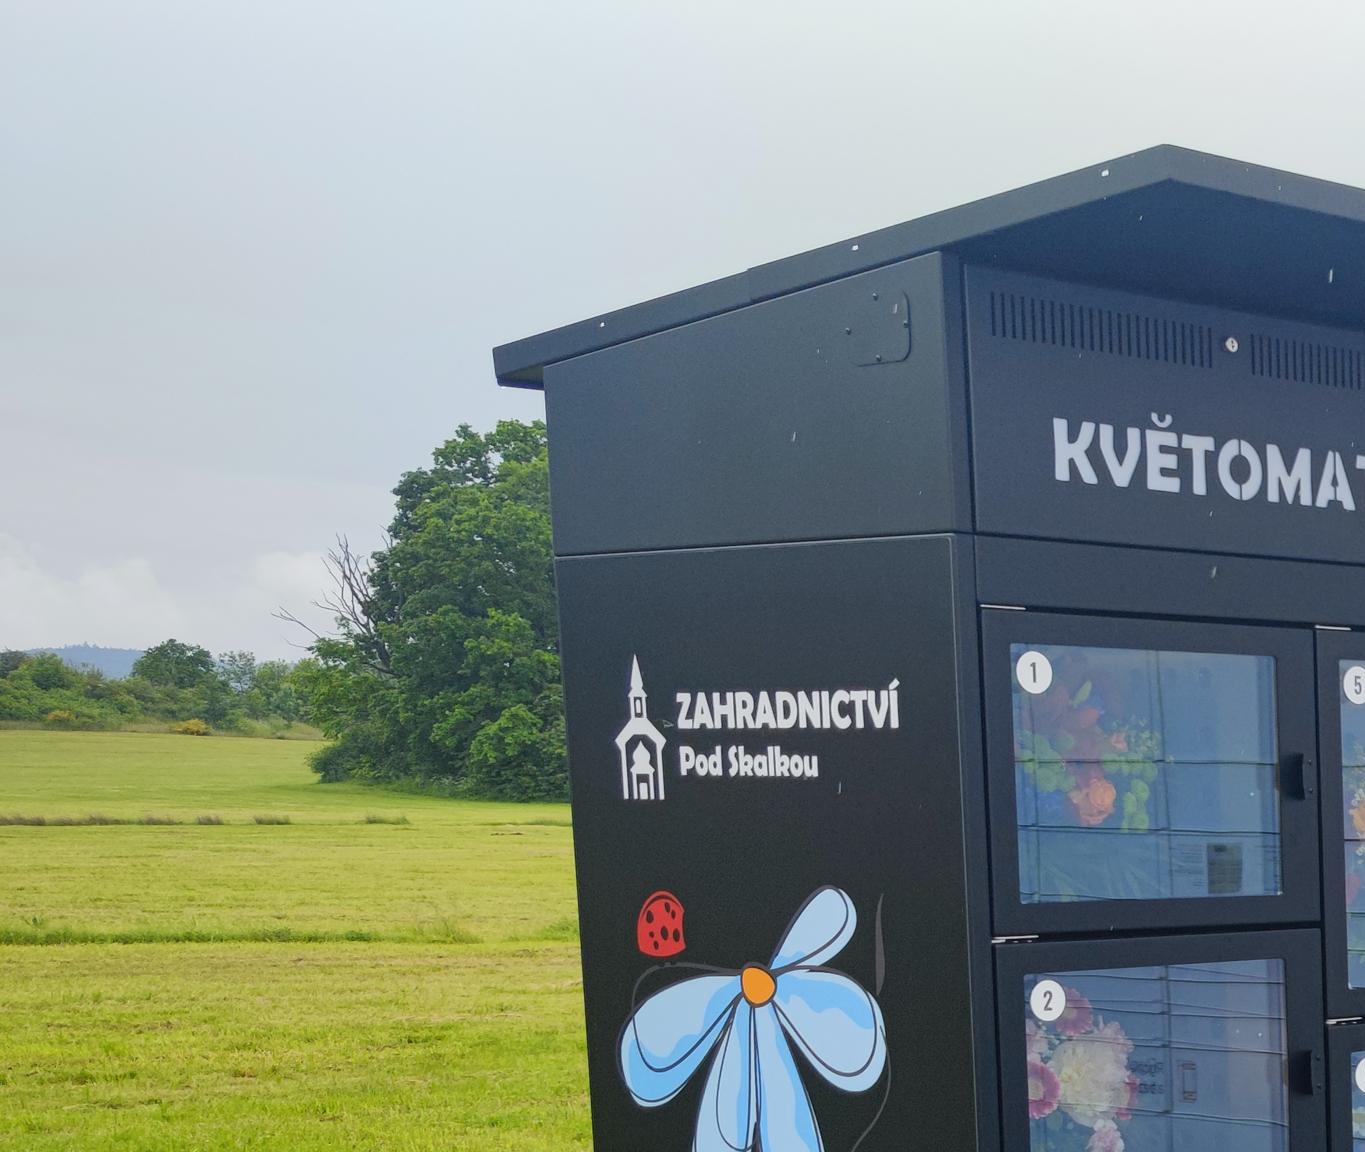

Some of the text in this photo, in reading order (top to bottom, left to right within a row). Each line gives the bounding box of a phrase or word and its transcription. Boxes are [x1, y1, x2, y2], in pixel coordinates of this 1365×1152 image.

[1030, 661, 1037, 684] 1
[1353, 675, 1363, 695] 5
[675, 677, 900, 730] ZAHRADNICTVÍ
[678, 744, 819, 778] Pod Skalkou
[1043, 990, 1053, 1010] 2
